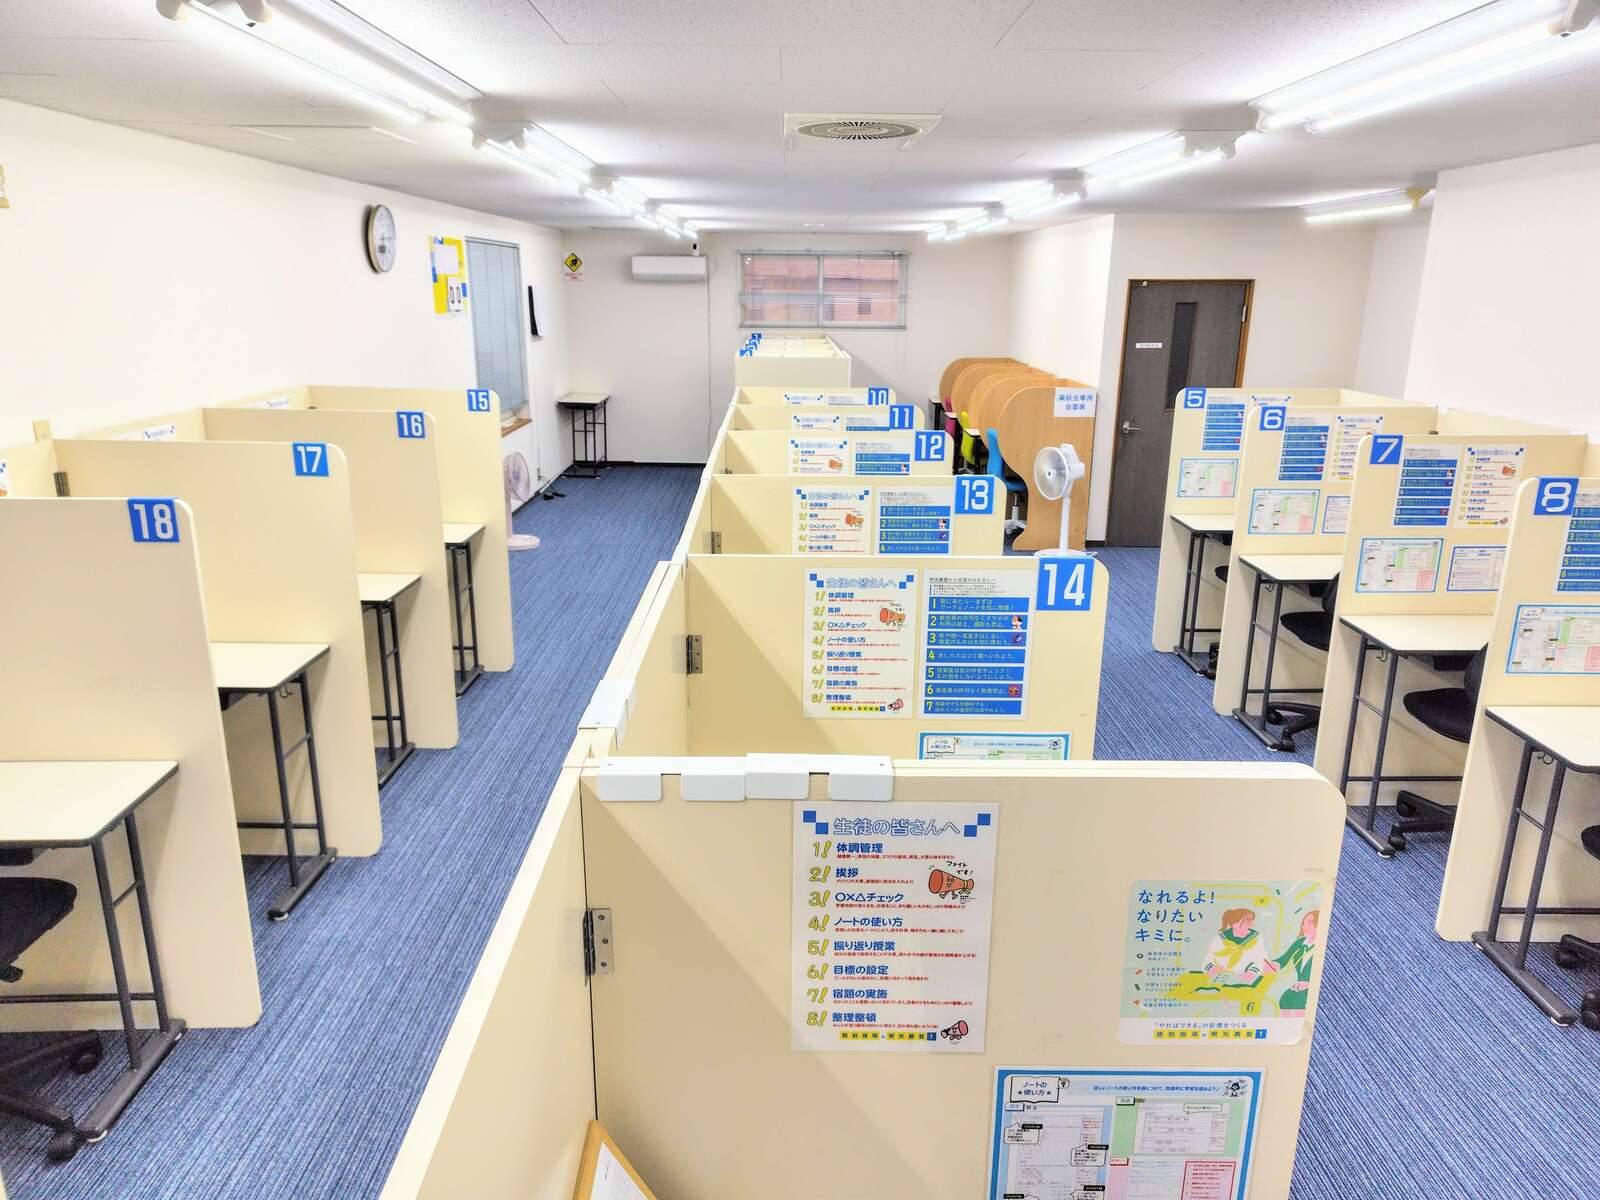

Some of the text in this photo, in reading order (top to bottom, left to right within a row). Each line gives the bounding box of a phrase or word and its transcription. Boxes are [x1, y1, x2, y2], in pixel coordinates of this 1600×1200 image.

[470, 392, 488, 410] 15
[870, 390, 886, 405] 10
[1186, 390, 1204, 408] 5
[400, 414, 422, 436] 16
[892, 408, 910, 428] 11
[1263, 409, 1282, 429] 6
[918, 434, 942, 459] 12
[1376, 438, 1400, 462] 7
[298, 446, 322, 473] 17
[961, 479, 990, 510] 13
[1541, 482, 1572, 512] 8
[133, 503, 173, 540] 18
[1044, 563, 1086, 606] 14
[932, 599, 936, 608] 1
[930, 616, 936, 626] 2
[930, 632, 936, 643] 3
[928, 649, 935, 660] 4
[928, 668, 934, 677] 5
[927, 684, 933, 694] 6
[927, 702, 932, 711] 7
[832, 818, 960, 837] 生徒の皆さんへ
[836, 842, 884, 854] 体調管理
[835, 867, 859, 878] 挨拶
[1138, 889, 1216, 904] なれるよ!
[834, 917, 904, 928] ノートの使い方
[1136, 909, 1203, 923] なりたい
[1135, 928, 1191, 943] キミに。
[834, 940, 896, 951] 振り返り授業
[834, 965, 889, 975] 目標の設定
[832, 988, 888, 999] 宿題の実施
[1246, 1002, 1255, 1012] 6
[832, 1012, 877, 1023] 整理整頓
